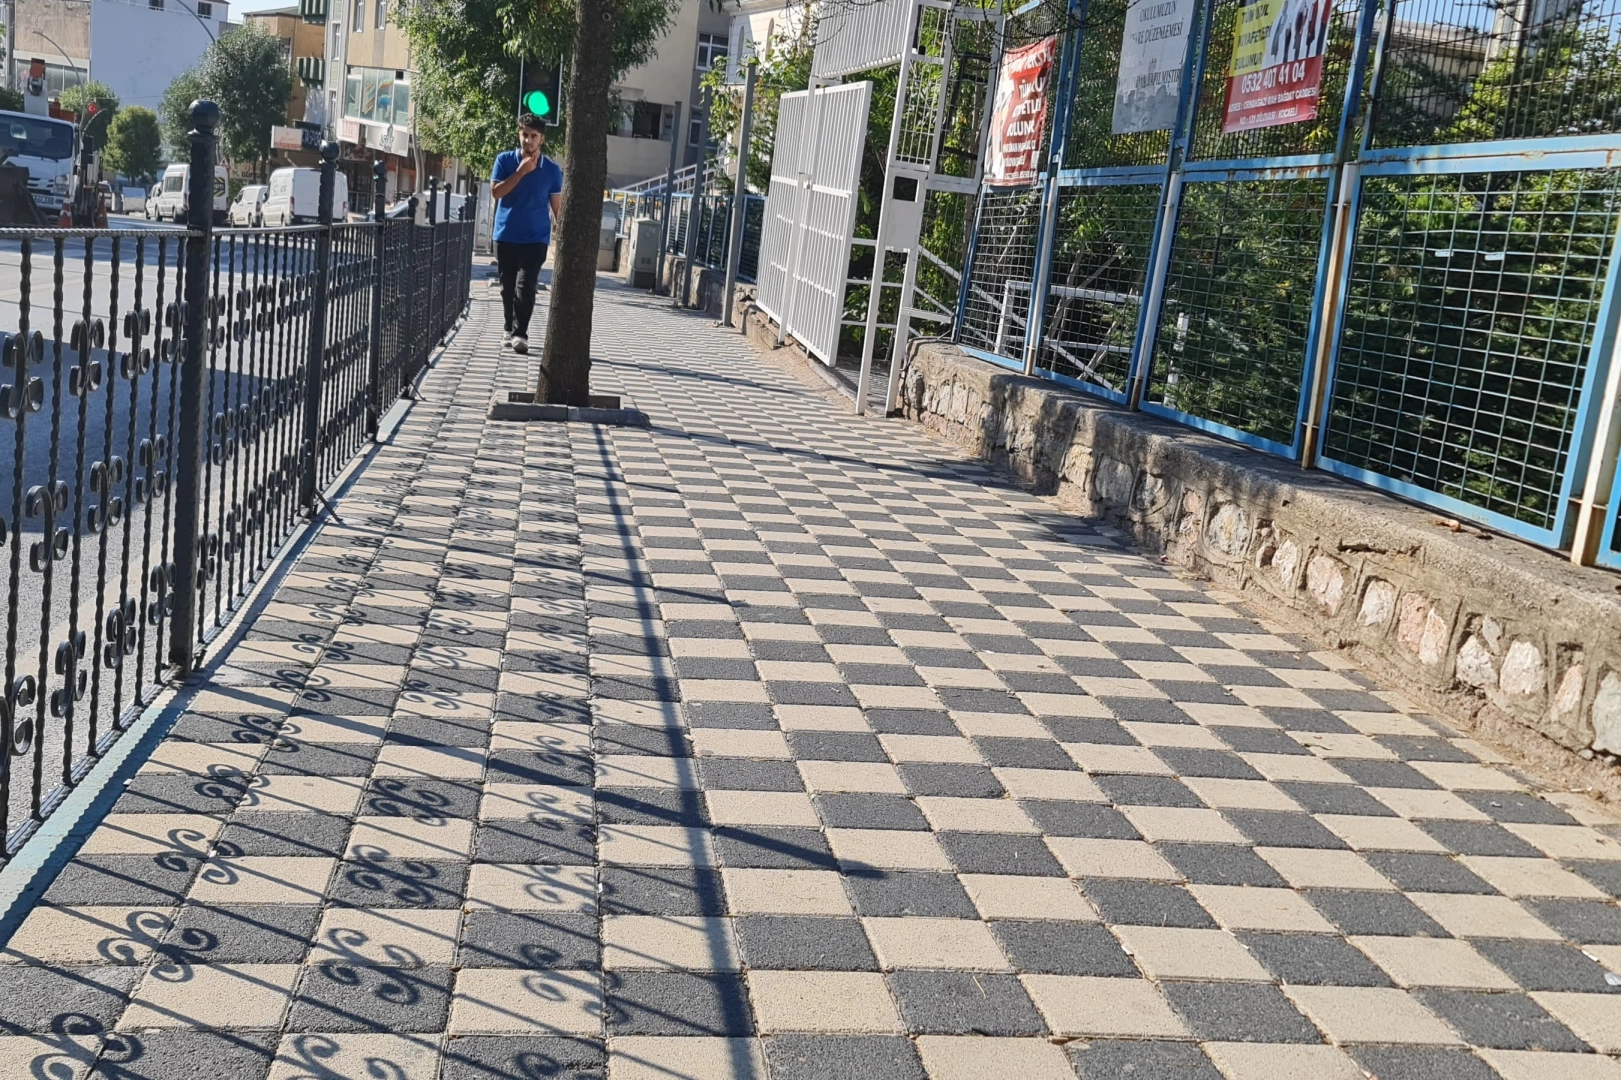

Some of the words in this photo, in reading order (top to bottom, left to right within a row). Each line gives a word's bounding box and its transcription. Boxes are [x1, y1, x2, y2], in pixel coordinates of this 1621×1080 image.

[1235, 52, 1263, 70] BULUNUR
[1241, 71, 1262, 94] 0532
[1263, 67, 1277, 89] 407
[1278, 64, 1289, 85] 41
[1292, 61, 1306, 83] 04
[1278, 105, 1298, 118] KOCAELİ
